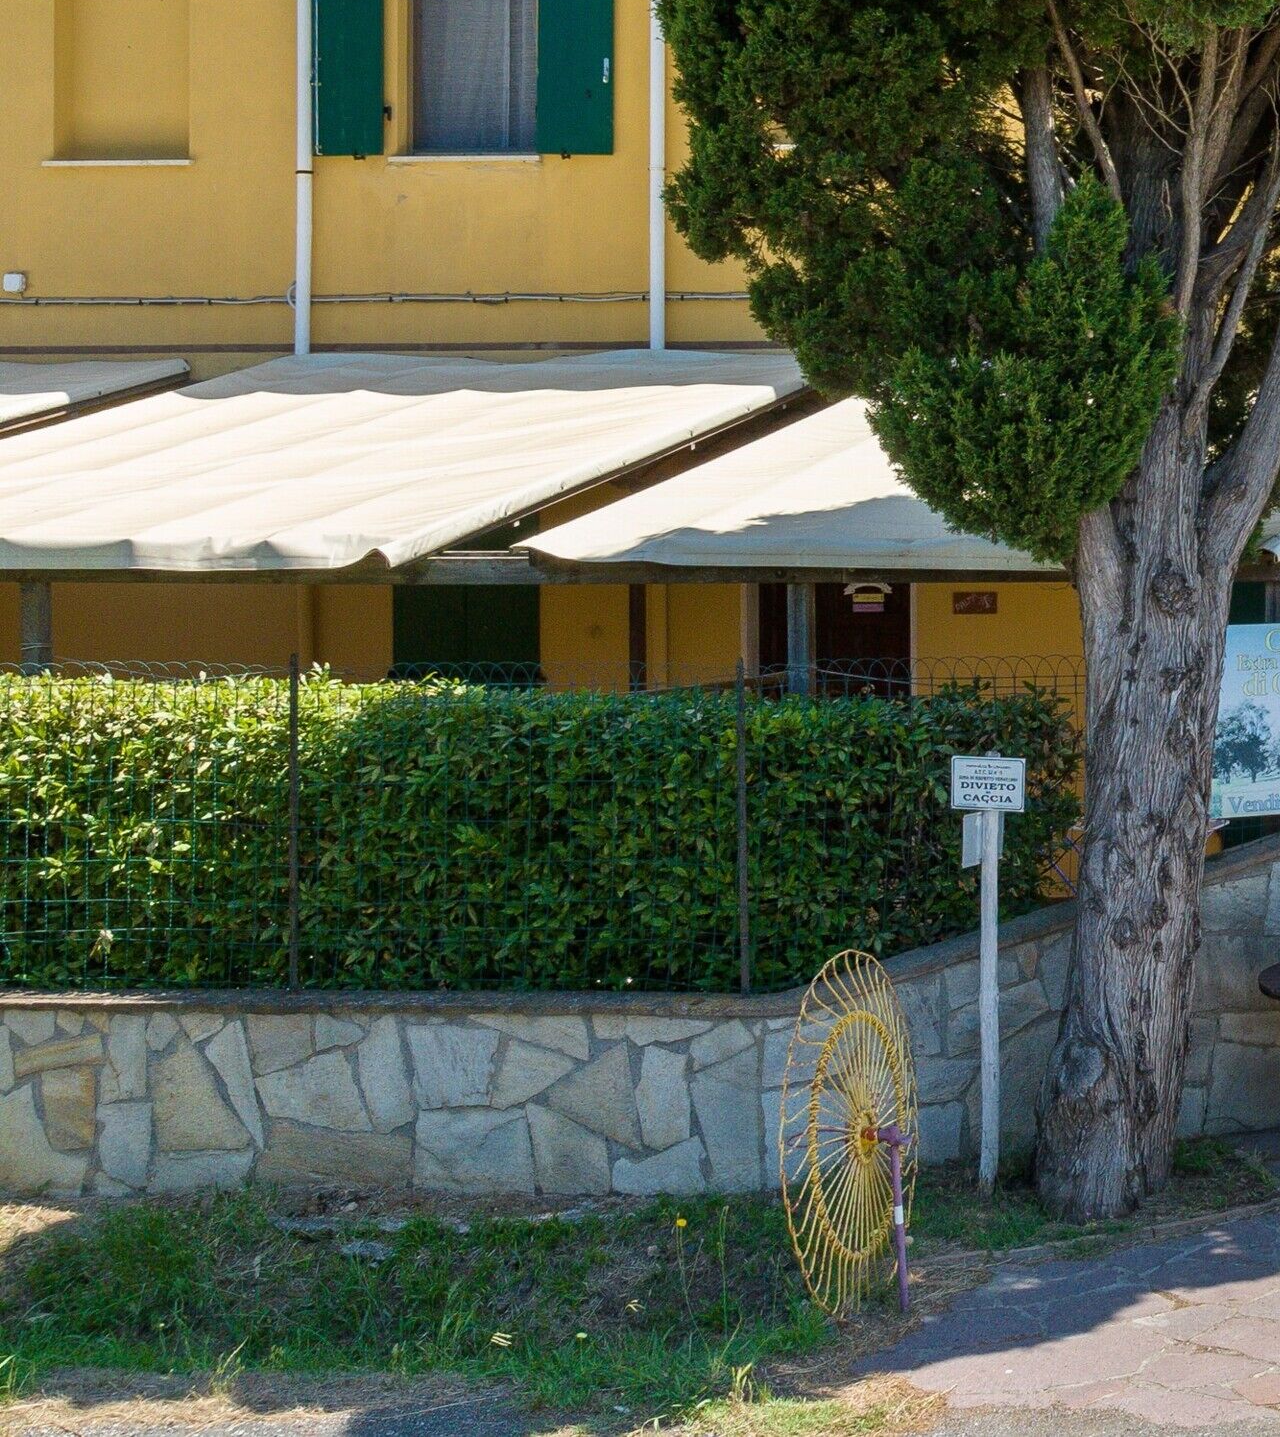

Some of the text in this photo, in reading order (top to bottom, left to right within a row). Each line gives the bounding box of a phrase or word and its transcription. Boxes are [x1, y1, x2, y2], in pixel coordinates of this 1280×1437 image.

[1236, 653, 1277, 671] Extra
[1242, 671, 1268, 696] di
[961, 781, 1016, 791] DIVIETO
[963, 793, 1013, 803] CACCIA
